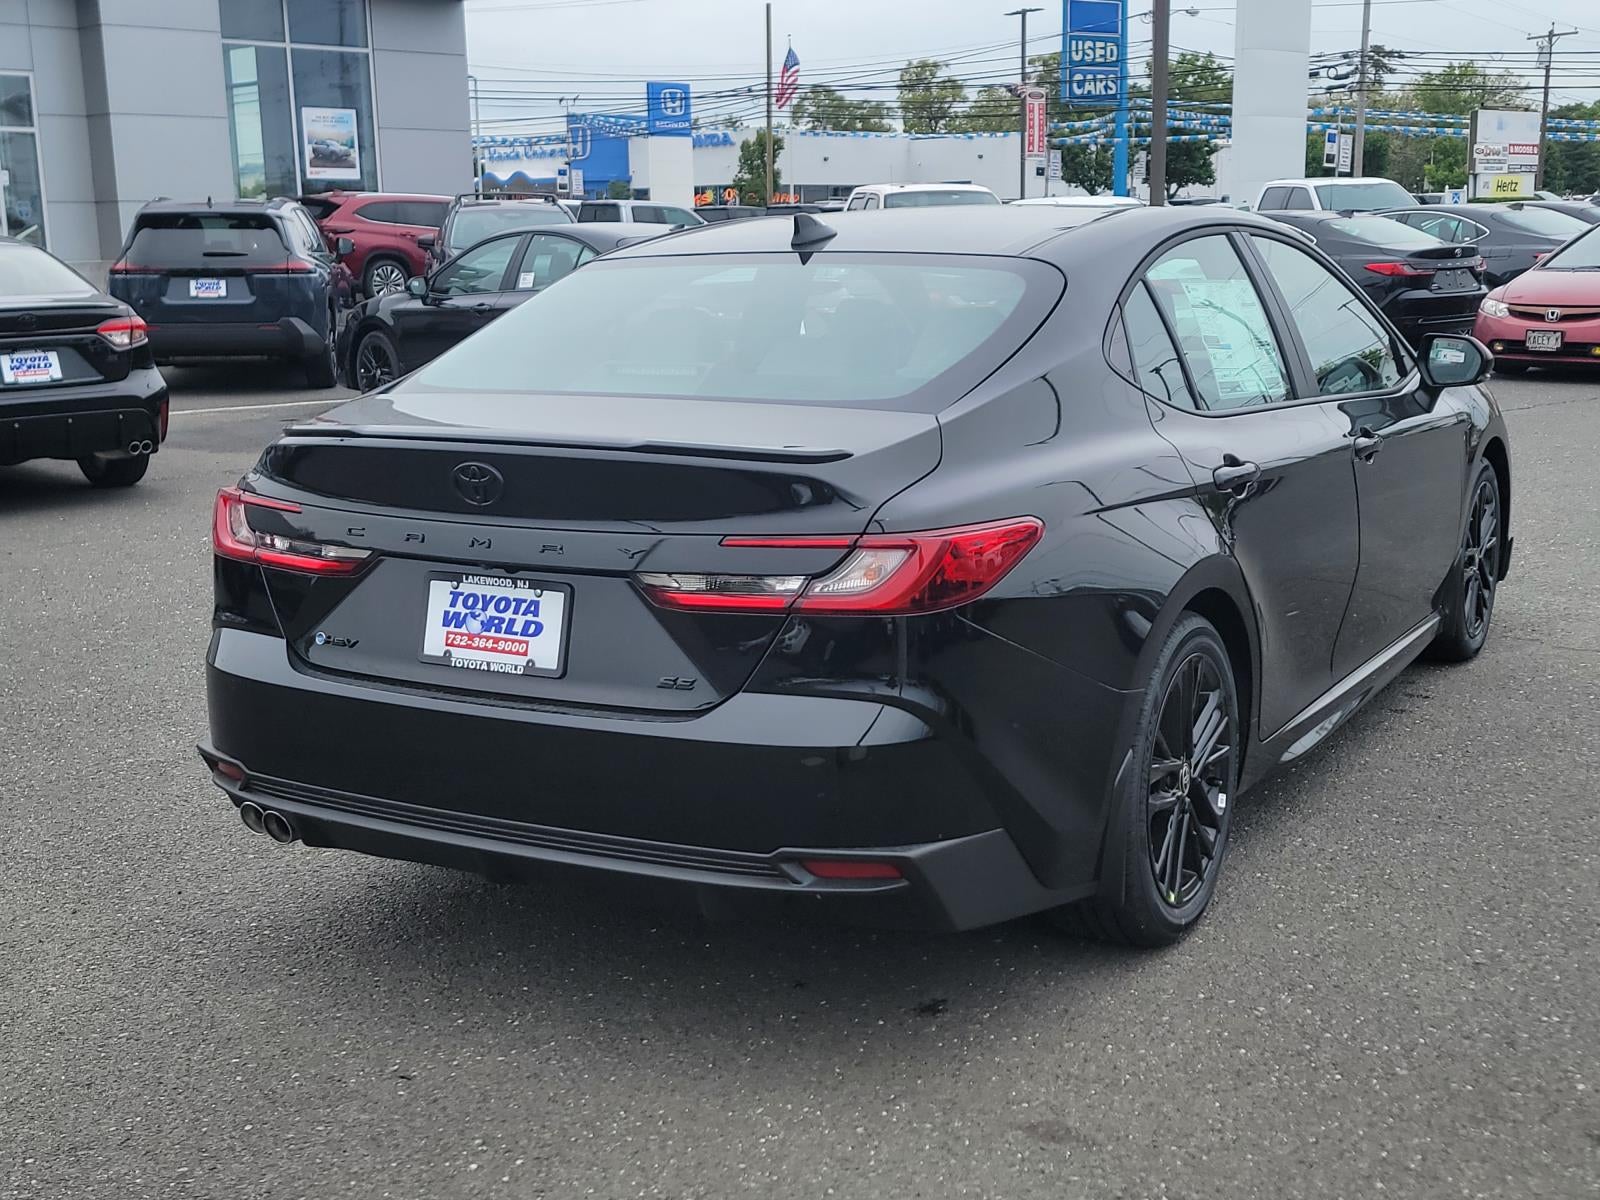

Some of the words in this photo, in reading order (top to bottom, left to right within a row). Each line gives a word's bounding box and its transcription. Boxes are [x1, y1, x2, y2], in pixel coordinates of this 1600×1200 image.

[1071, 40, 1118, 62] USED
[1072, 73, 1117, 95] CARS
[1496, 179, 1519, 192] Hertz
[10, 355, 49, 364] TOYOTA
[346, 526, 647, 560] CAMRY
[462, 574, 515, 588] LAKEWOOD,
[517, 580, 529, 589] NJ
[449, 590, 540, 618] TOYOTA
[447, 634, 527, 653] 732-364-9000
[450, 657, 488, 671] TOYOTA
[490, 661, 524, 675] WORLD
[657, 676, 697, 690] SE
